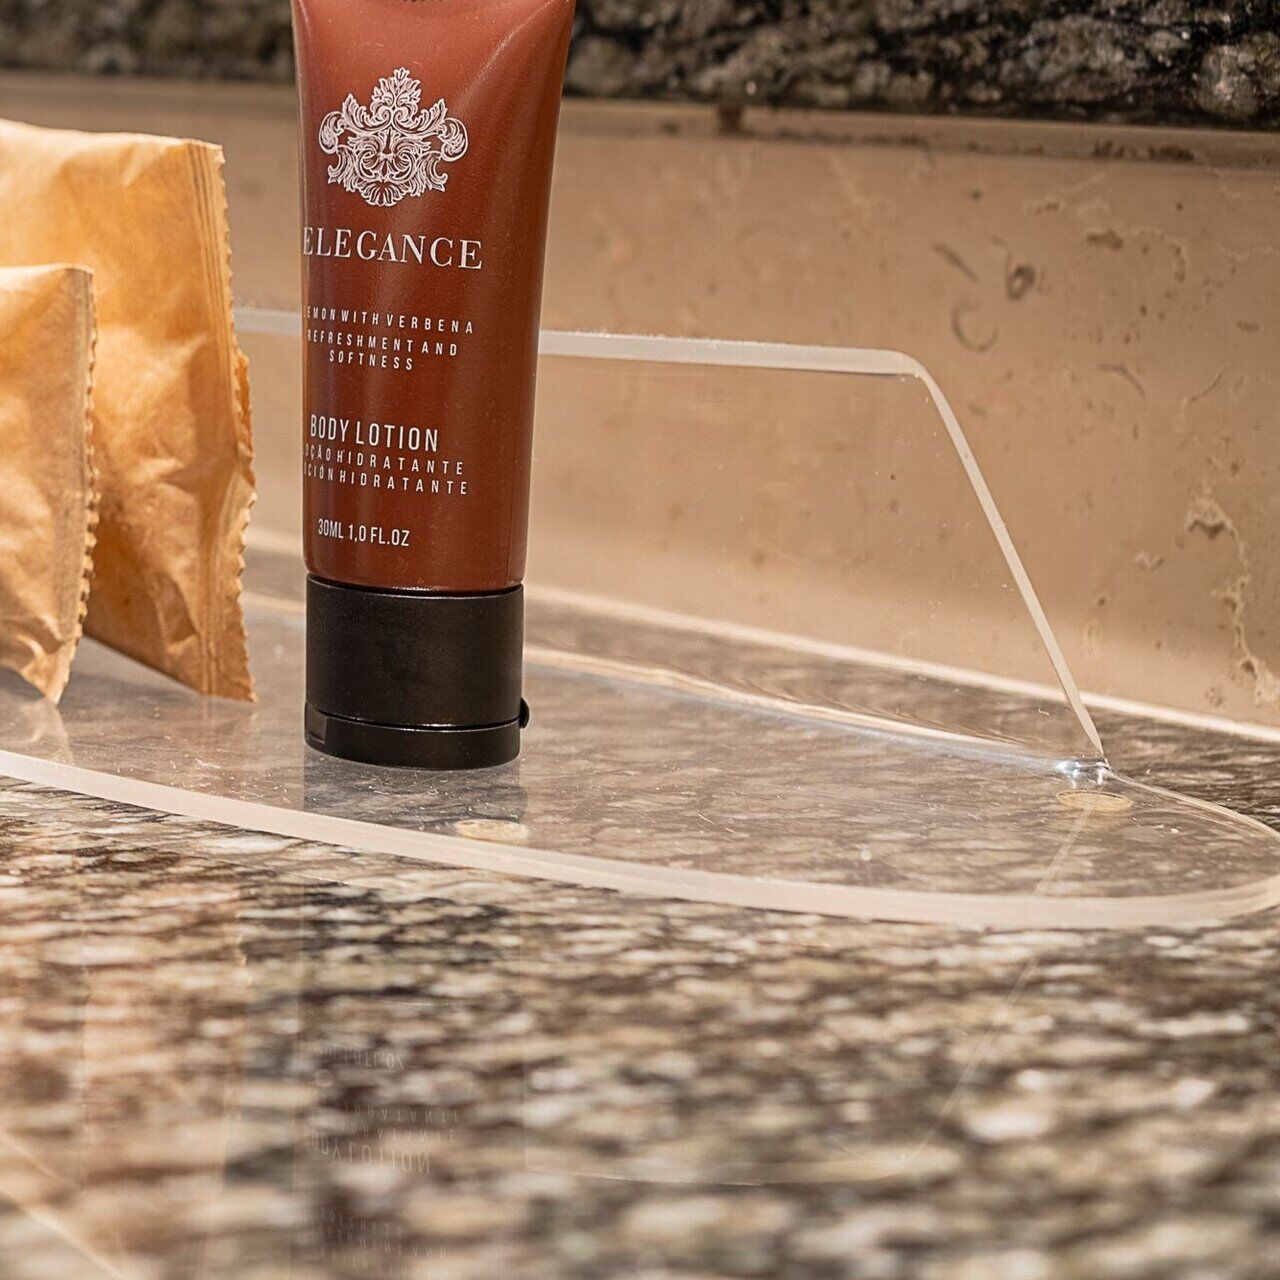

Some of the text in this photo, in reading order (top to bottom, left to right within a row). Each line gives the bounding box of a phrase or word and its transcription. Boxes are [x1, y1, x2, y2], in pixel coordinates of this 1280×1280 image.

[303, 226, 482, 269] ELEGANCE
[341, 309, 379, 325] WITH
[386, 314, 473, 333] VERBENA
[307, 329, 457, 356] REFRESHMENT AND
[329, 349, 413, 370] SOFTNESS
[310, 413, 438, 452] BODY LOTION
[337, 450, 463, 475] HIDRATANTE
[340, 469, 467, 494] HIDRATANTE
[318, 518, 344, 539] 30ML
[348, 524, 367, 542] 1,0
